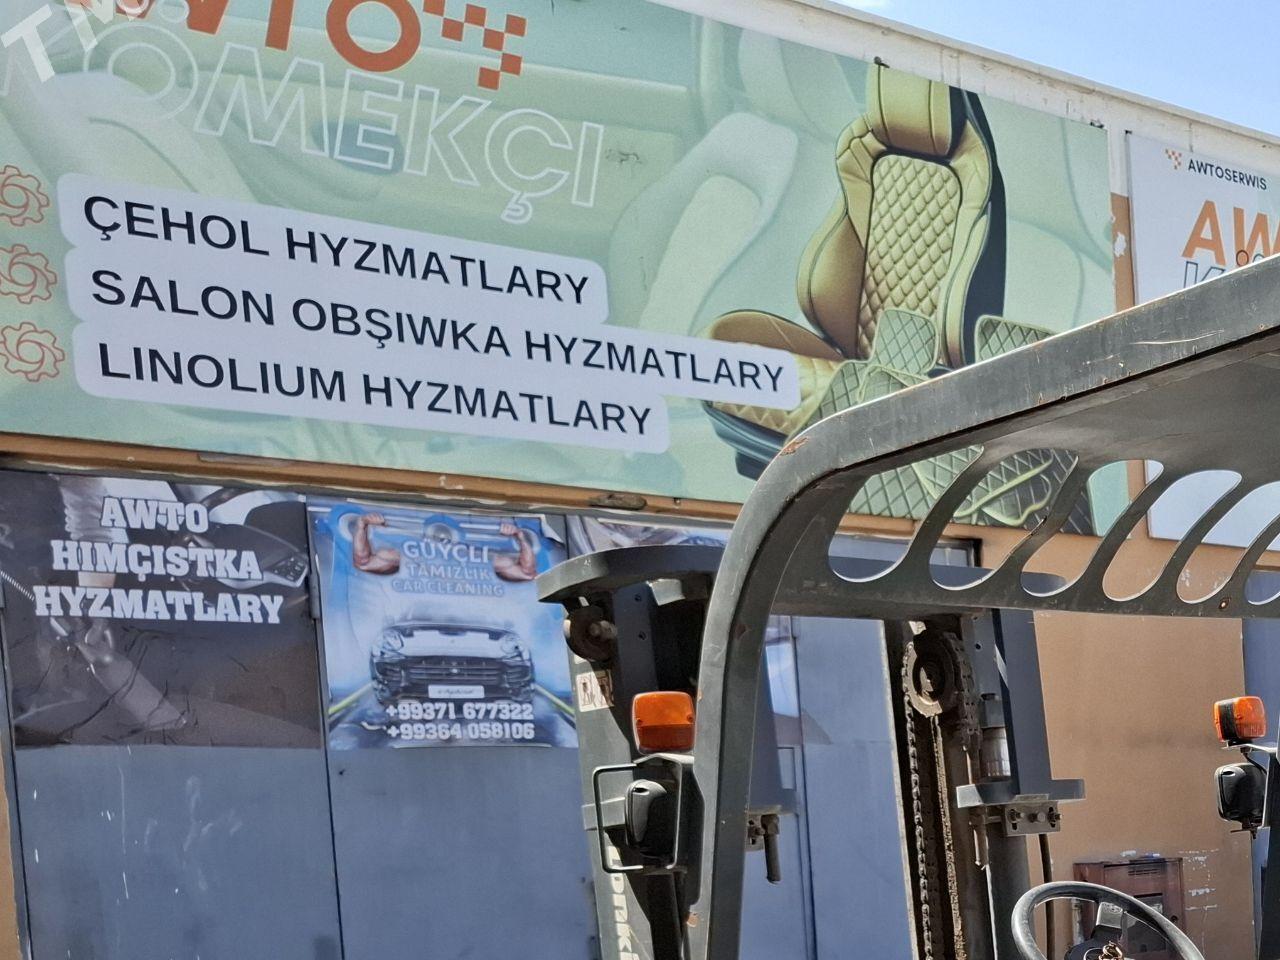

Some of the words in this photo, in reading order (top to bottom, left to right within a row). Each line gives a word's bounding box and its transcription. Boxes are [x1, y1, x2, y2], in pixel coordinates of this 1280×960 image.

[0, 0, 605, 223] ÖMEKÇI
[1188, 159, 1268, 190] AWTOSERWIS
[83, 195, 270, 257] ÇEHOL
[286, 227, 590, 306] HYZMATLARY
[91, 268, 274, 327] SALON
[292, 297, 511, 359] OBŞIWKA
[524, 330, 785, 394] HYZMATLARY
[98, 342, 347, 405] LINOLIUM
[363, 374, 652, 438] HYZMATLARY
[101, 497, 208, 534] AWTO
[52, 541, 263, 582] HIMÇISTKA
[35, 586, 284, 624] HYZMATLARY
[392, 579, 427, 593] CAR
[428, 581, 505, 598] CLEANING
[386, 702, 456, 720] +99371
[462, 702, 535, 720] 677322
[467, 723, 535, 740] 058106
